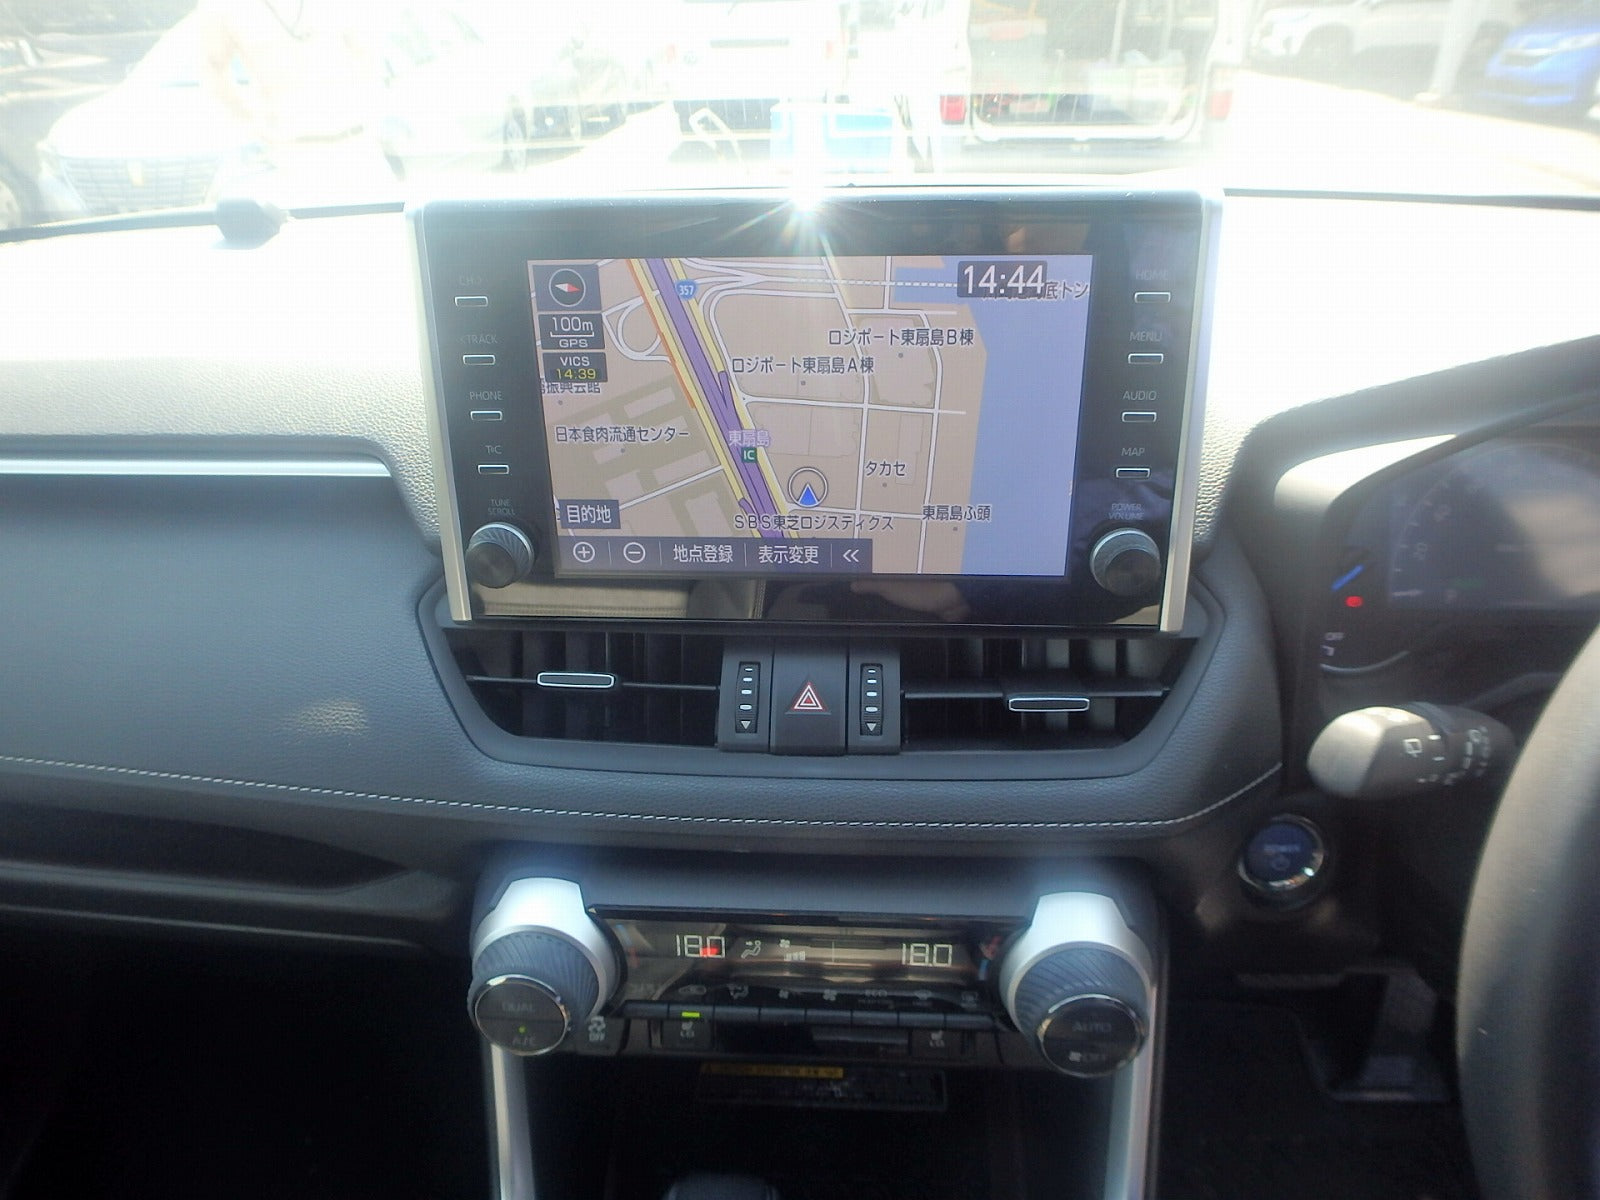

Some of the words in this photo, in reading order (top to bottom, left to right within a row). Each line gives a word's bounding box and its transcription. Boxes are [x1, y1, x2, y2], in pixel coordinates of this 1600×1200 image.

[964, 264, 1045, 295] 14:44
[678, 283, 694, 297] 357
[552, 316, 593, 331] 100m
[559, 339, 588, 348] GPS
[828, 328, 975, 347] ロジポート東扇島B棟
[1129, 331, 1162, 342] MENU
[560, 356, 590, 366] VICS
[732, 356, 875, 375] ロジポート東扇島A棟
[556, 368, 596, 380] 14:39
[469, 390, 503, 401] PHONE
[1122, 391, 1157, 401] AUDIO
[555, 426, 689, 443] 日本食肉流通センター
[728, 430, 771, 448] 東扇島
[743, 450, 755, 460] IC
[1121, 448, 1145, 457] MAP
[865, 461, 906, 477] タカセ
[566, 505, 612, 524] 目的地
[922, 505, 991, 522] 東扇島ふ頭
[673, 545, 733, 564] 地点登録
[758, 545, 819, 565] 表示変更
